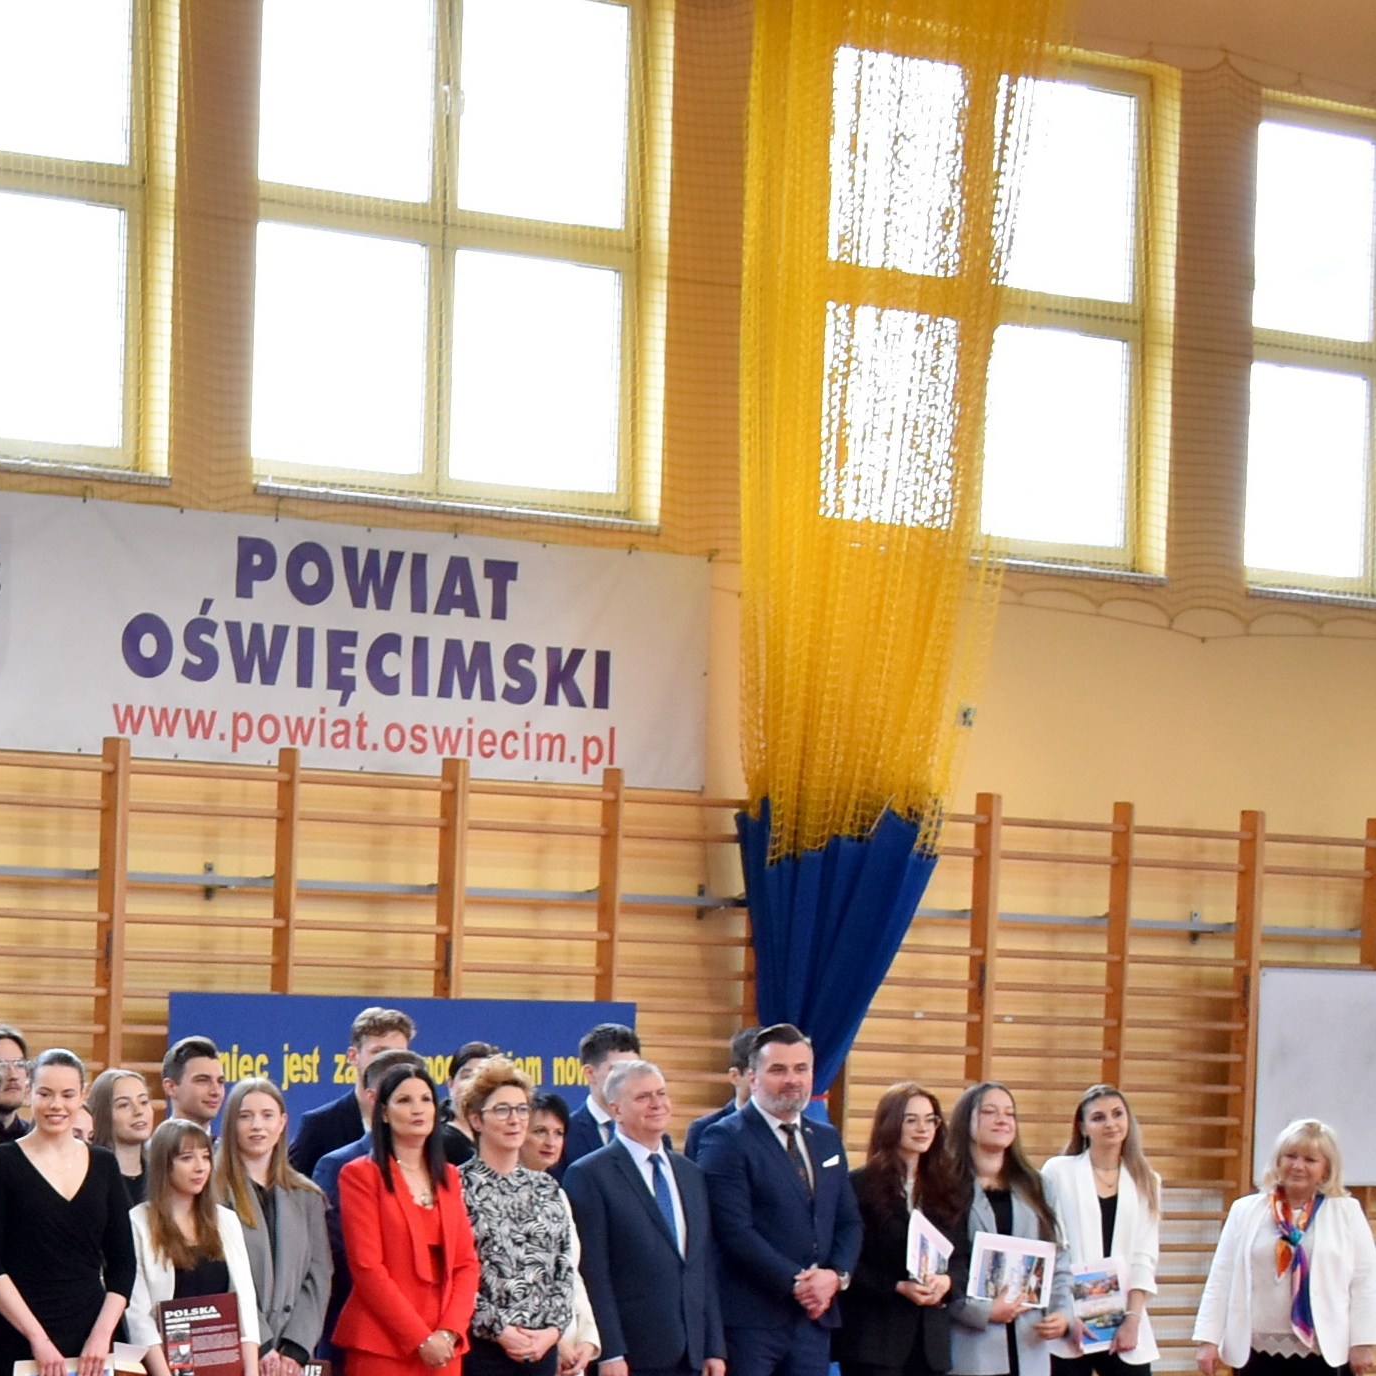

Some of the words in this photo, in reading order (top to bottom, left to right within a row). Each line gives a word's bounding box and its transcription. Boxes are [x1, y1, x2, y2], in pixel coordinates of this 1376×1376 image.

[235, 536, 519, 621] POWIAT
[121, 598, 611, 709] OŚWIĘCIMSKI
[112, 703, 616, 775] www.powiat.oswiecim.pl
[220, 1044, 269, 1082] niec
[281, 1043, 320, 1091] jest
[164, 1305, 218, 1319] POLSKA
